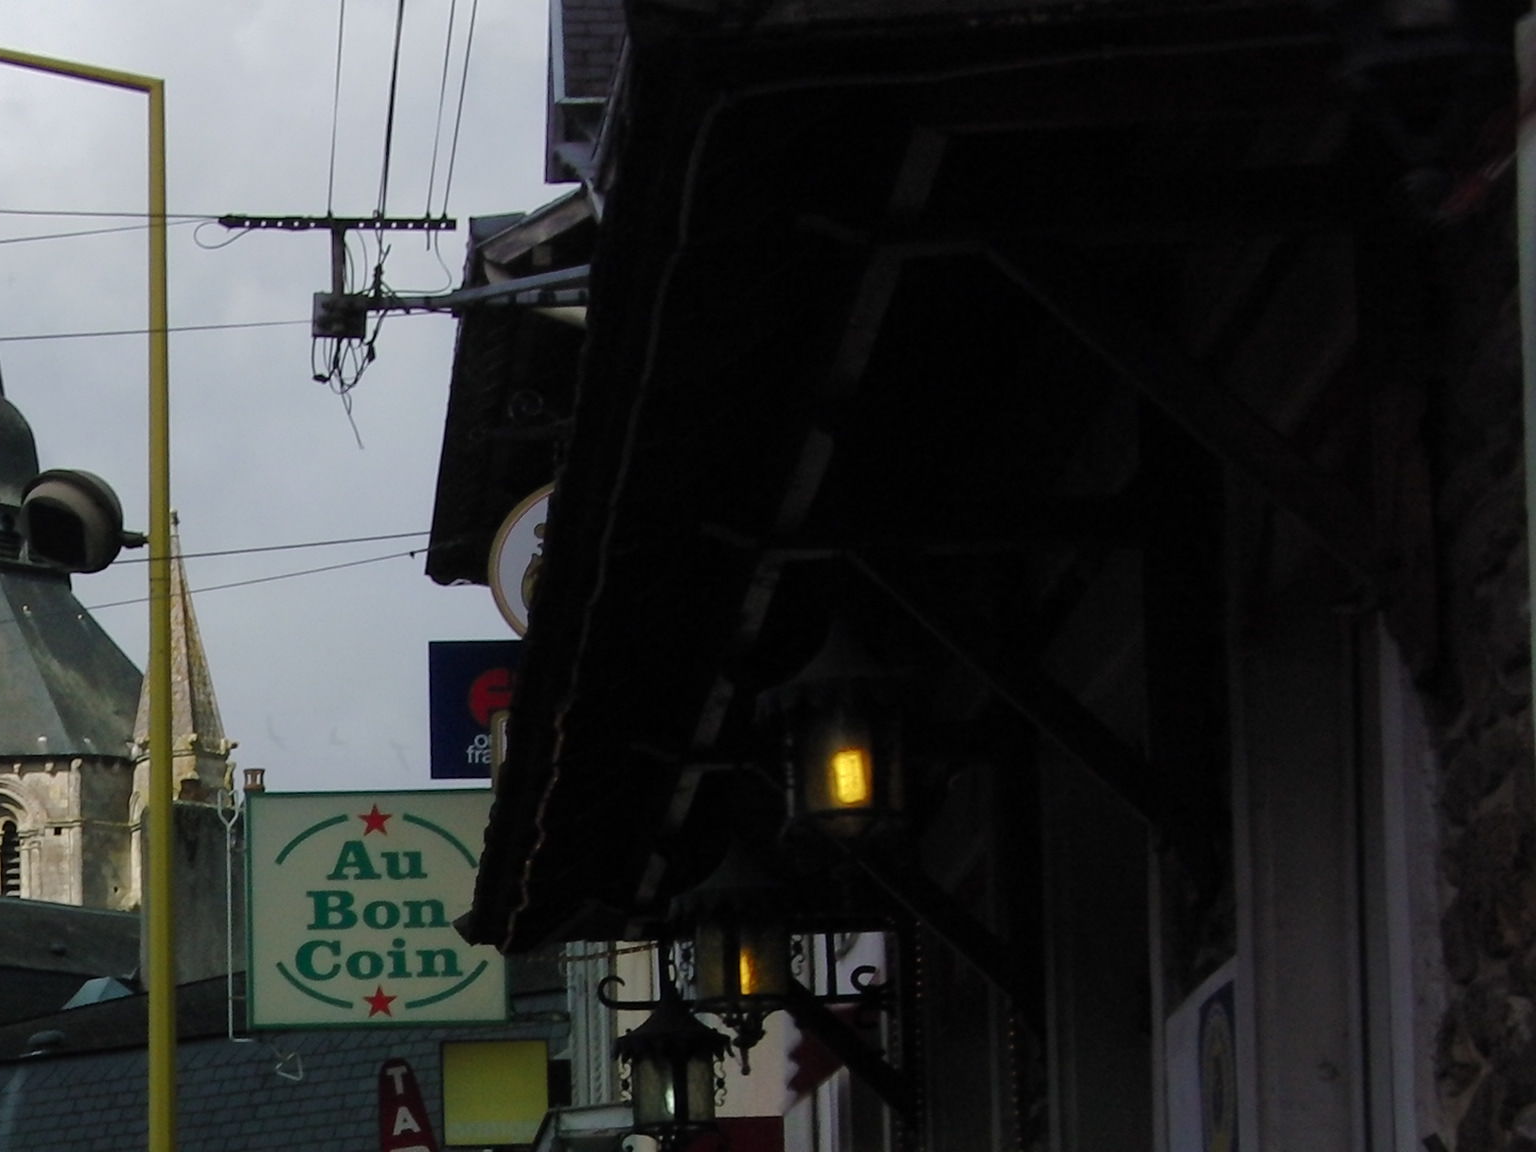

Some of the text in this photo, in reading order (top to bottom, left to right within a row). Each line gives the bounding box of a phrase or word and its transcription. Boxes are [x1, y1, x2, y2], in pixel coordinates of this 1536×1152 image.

[326, 840, 428, 880] Au
[306, 890, 451, 930] Bon
[295, 937, 463, 981] Coin
